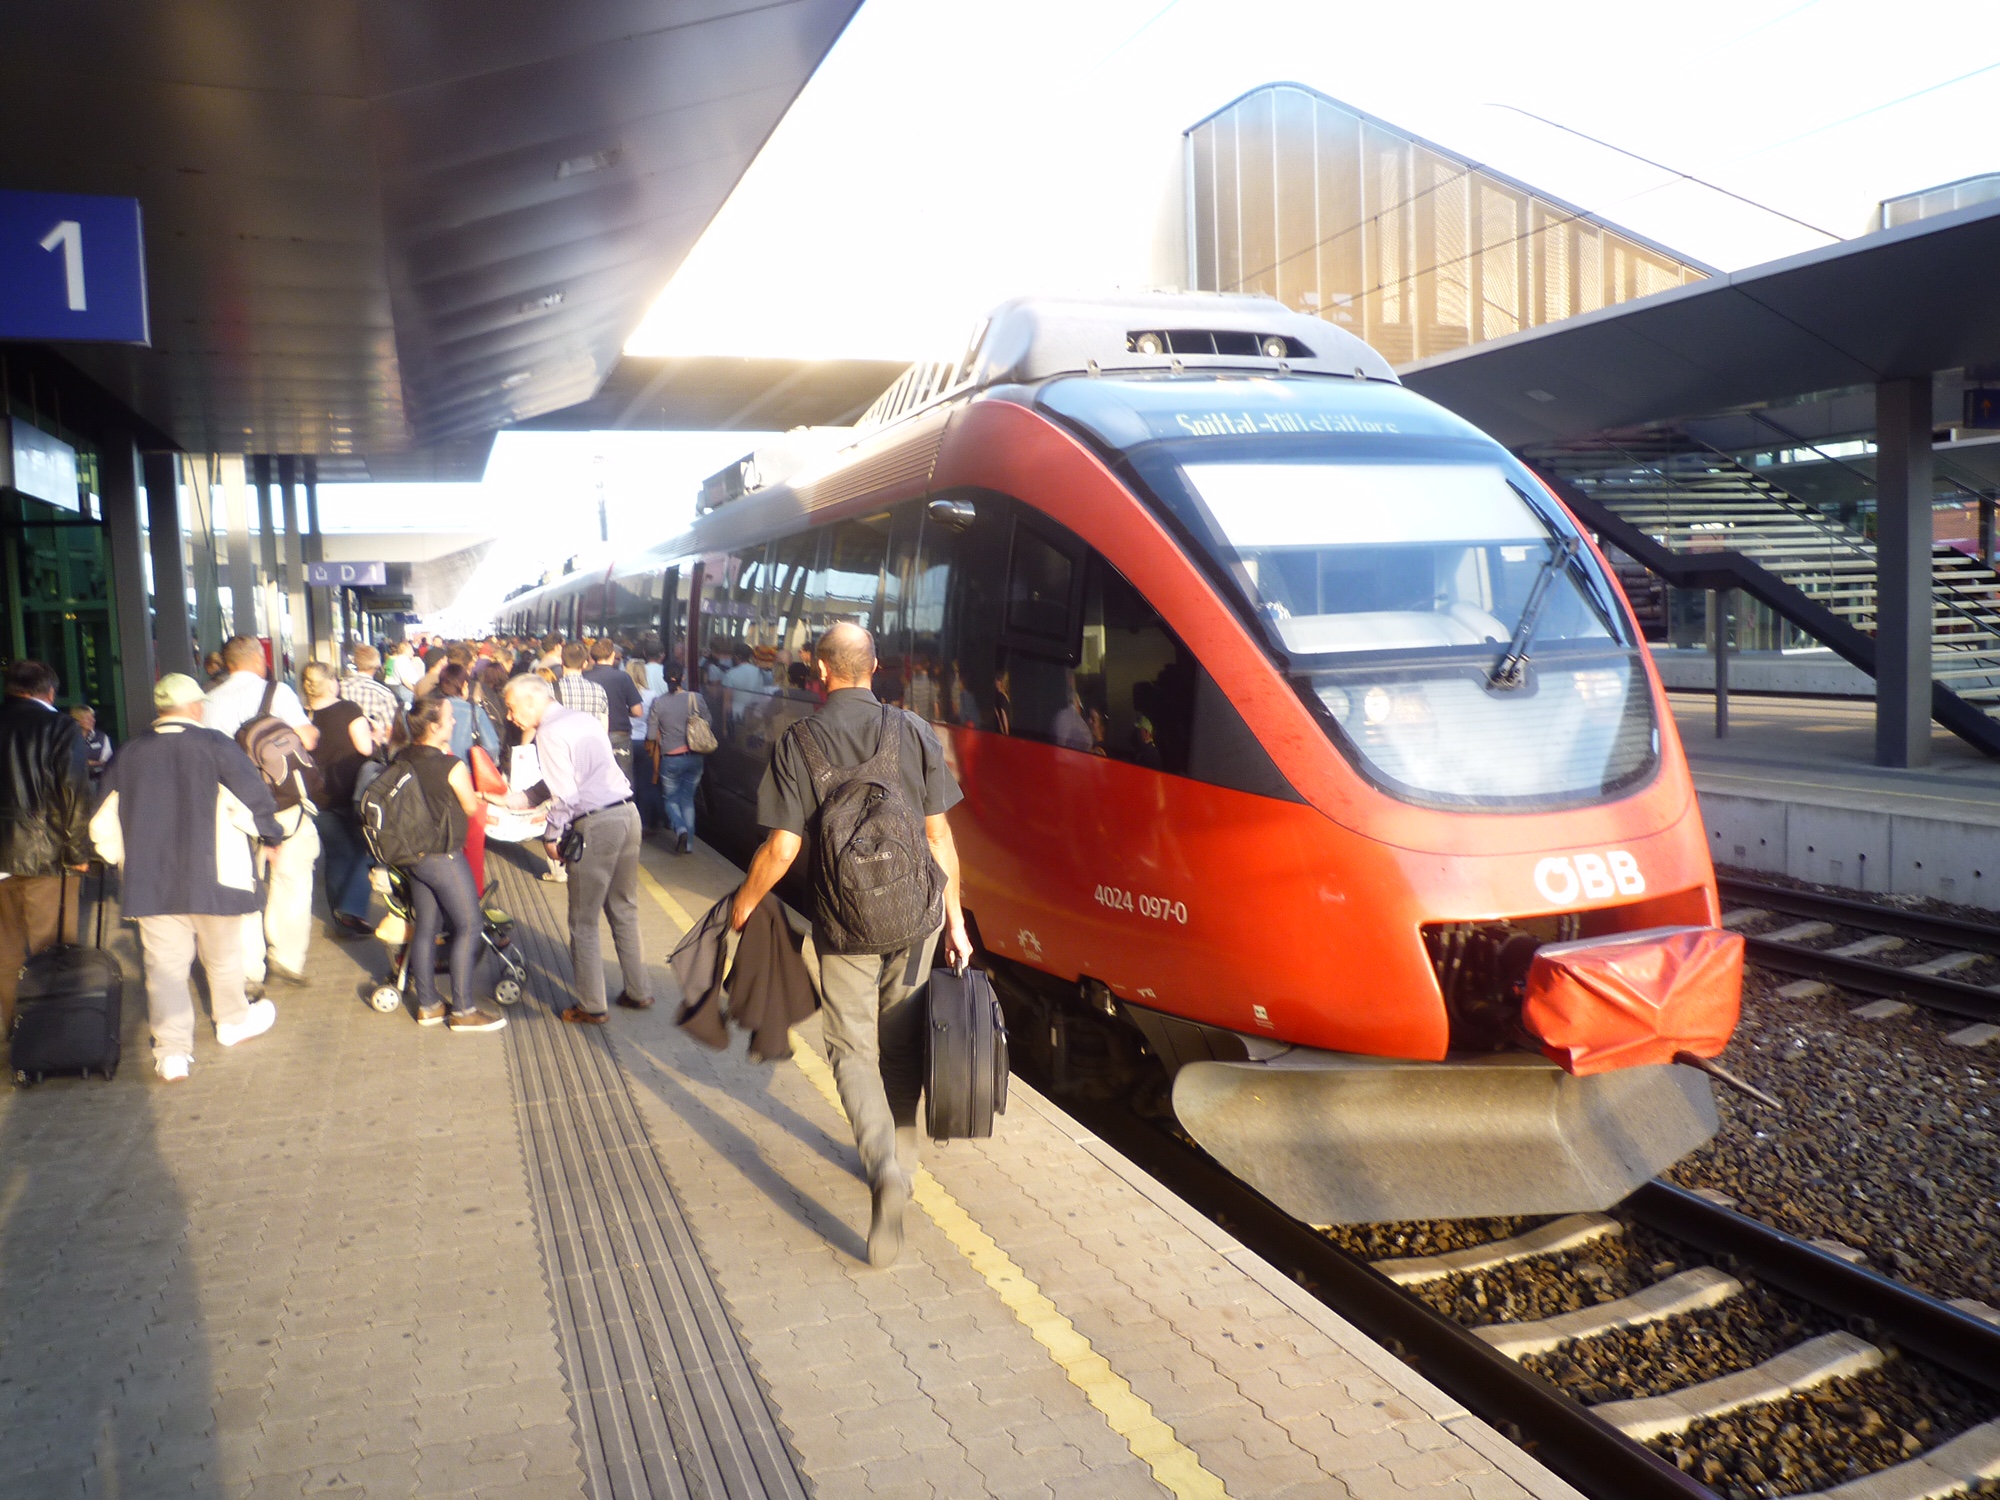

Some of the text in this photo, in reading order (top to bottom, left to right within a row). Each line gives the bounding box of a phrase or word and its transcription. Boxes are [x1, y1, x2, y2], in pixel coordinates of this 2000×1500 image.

[39, 221, 87, 311] 1
[341, 563, 378, 582] D 1
[1534, 851, 1646, 905] ÖBB
[1094, 884, 1188, 925] 4024 097-0
